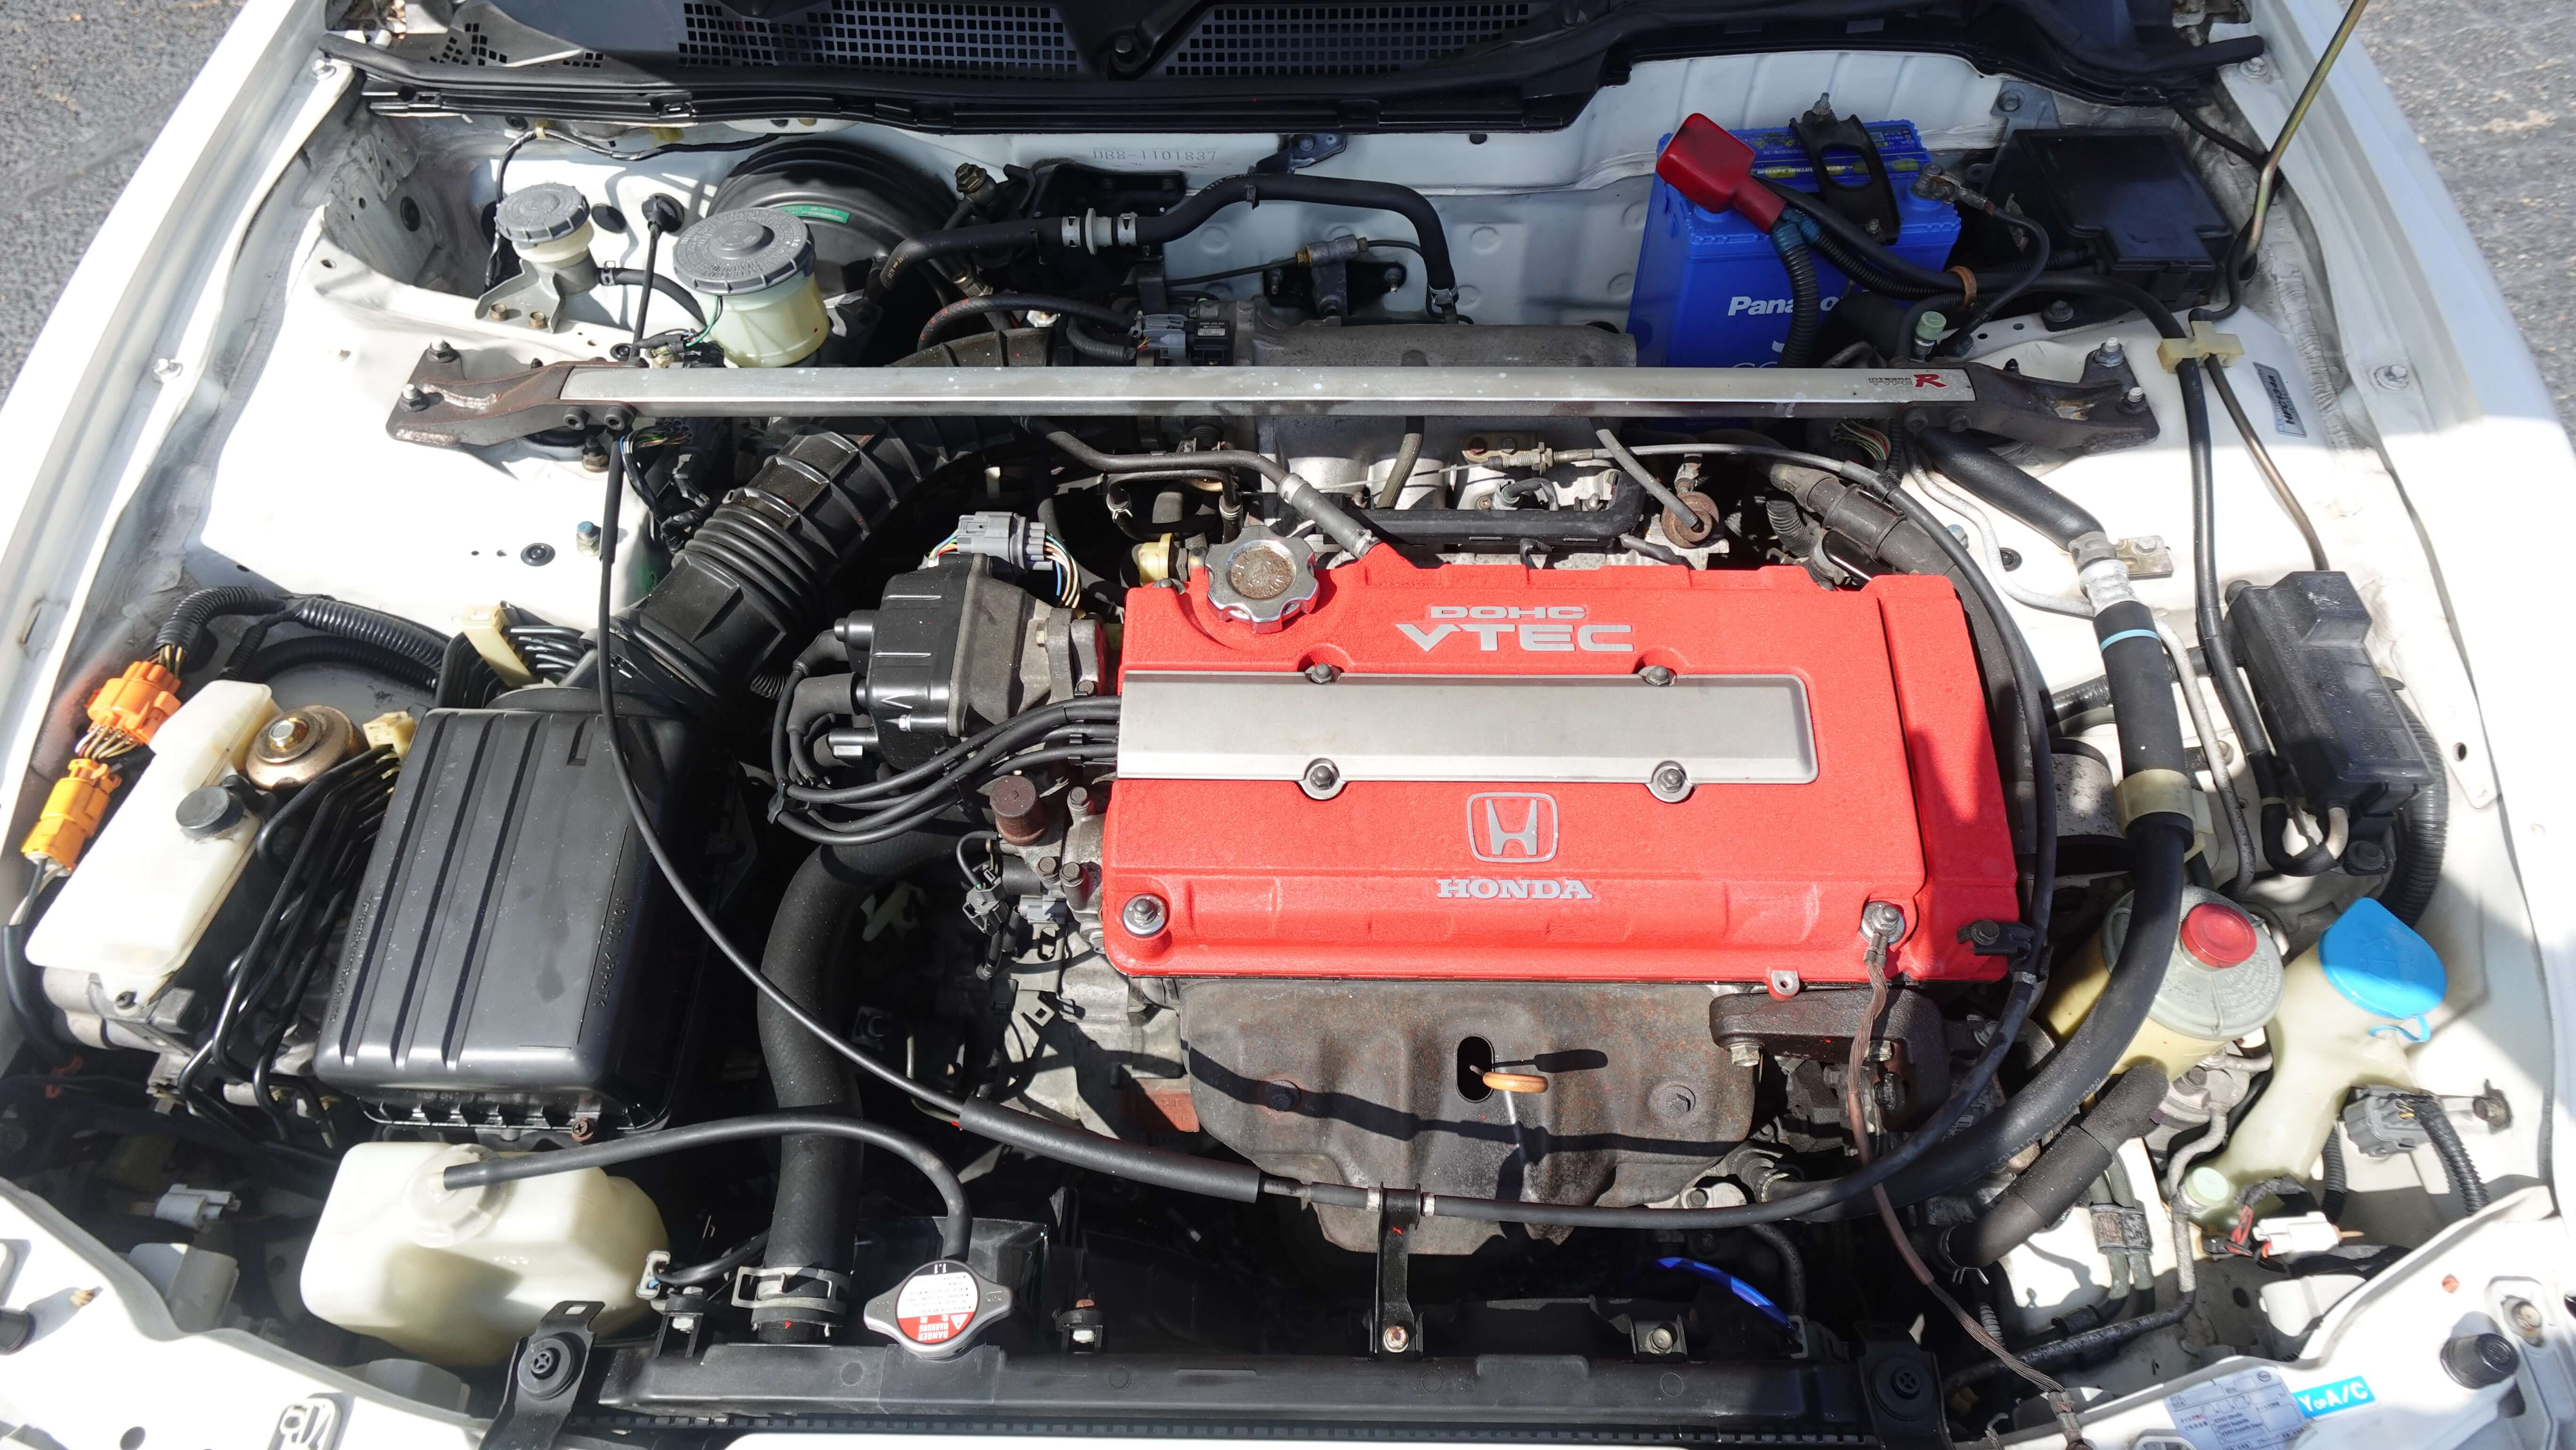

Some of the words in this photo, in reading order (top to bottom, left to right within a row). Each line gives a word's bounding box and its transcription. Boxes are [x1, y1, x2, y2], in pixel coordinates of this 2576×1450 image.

[1913, 373, 1948, 388] R
[1430, 606, 1586, 620] DOHC
[1396, 624, 1635, 652] VTEC
[1437, 879, 1594, 900] HONDA
[934, 1263, 947, 1273] 1.1
[918, 1331, 949, 1341] DANGER
